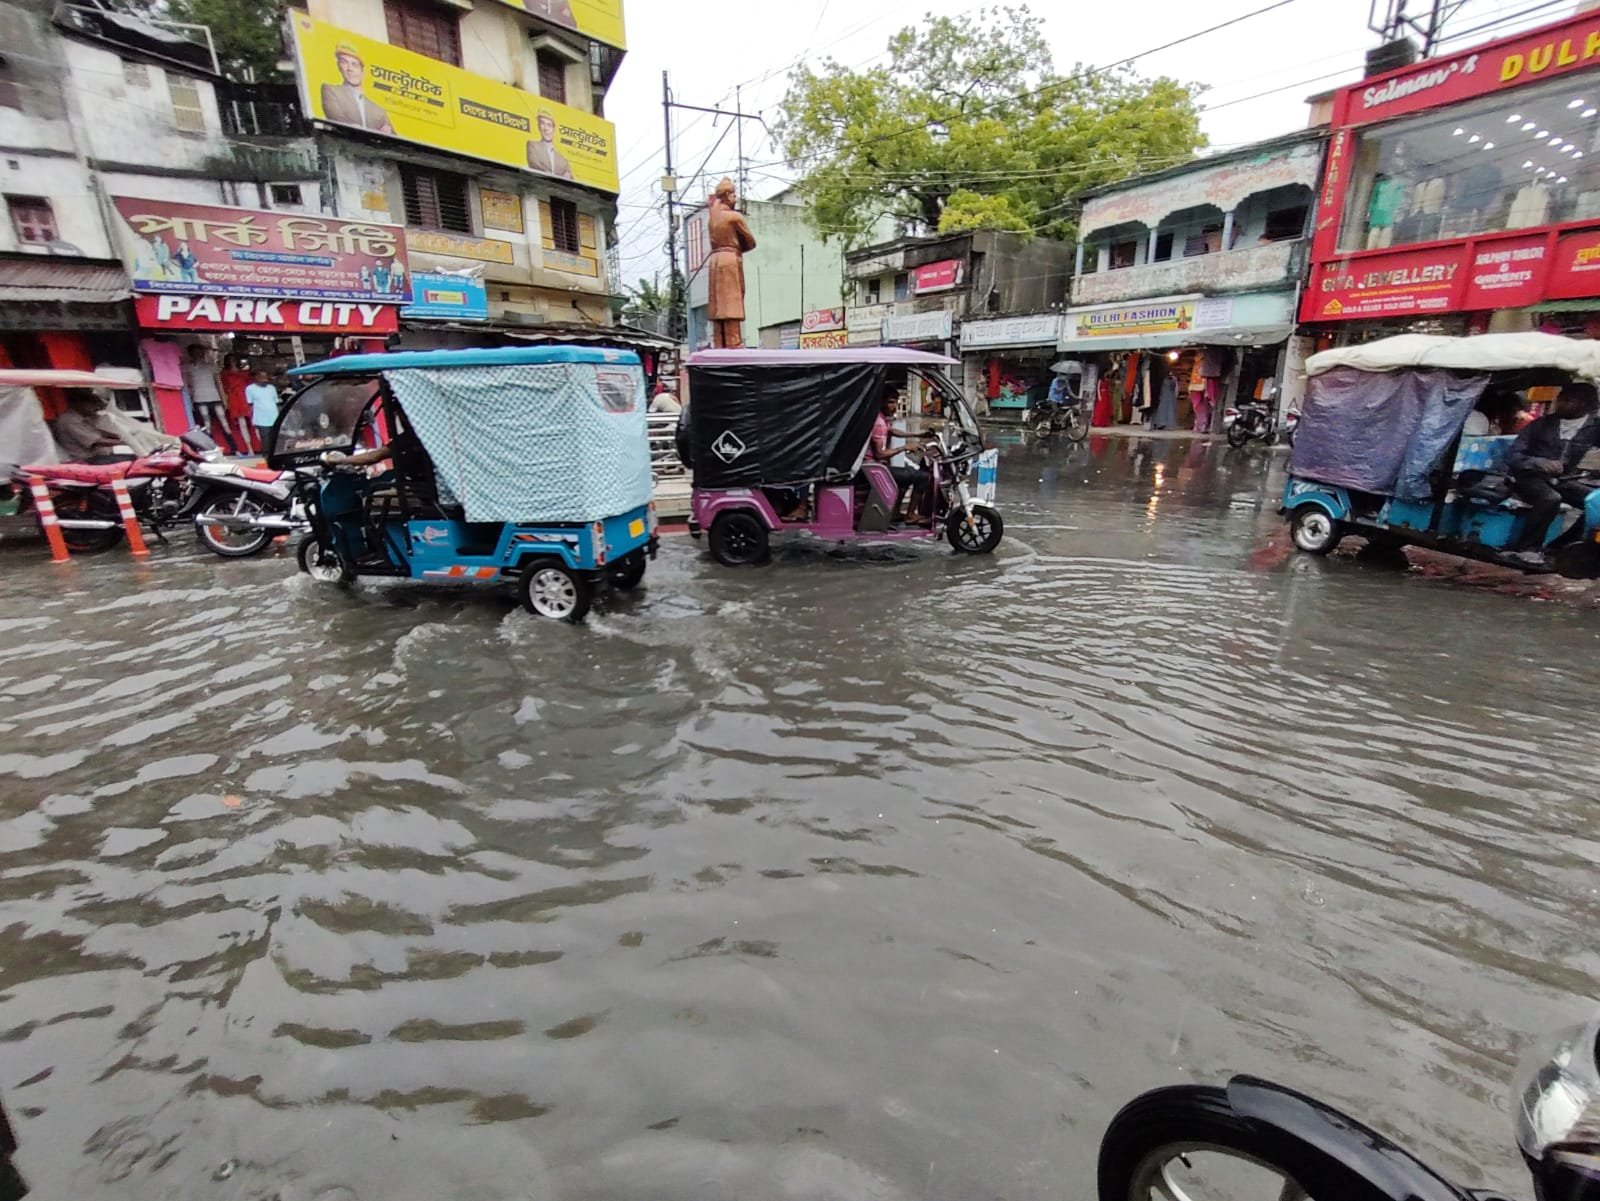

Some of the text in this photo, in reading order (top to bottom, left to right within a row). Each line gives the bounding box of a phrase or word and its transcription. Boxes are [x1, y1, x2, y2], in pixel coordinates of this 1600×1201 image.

[370, 64, 442, 96] আল্ট্রাটেক
[129, 214, 269, 247] পার্ক
[276, 217, 397, 257] সিটি
[1358, 263, 1458, 289] JEWELLERY
[157, 294, 384, 327] PARK CITY
[1090, 312, 1120, 324] DELHI
[1124, 307, 1177, 321] FASHION
